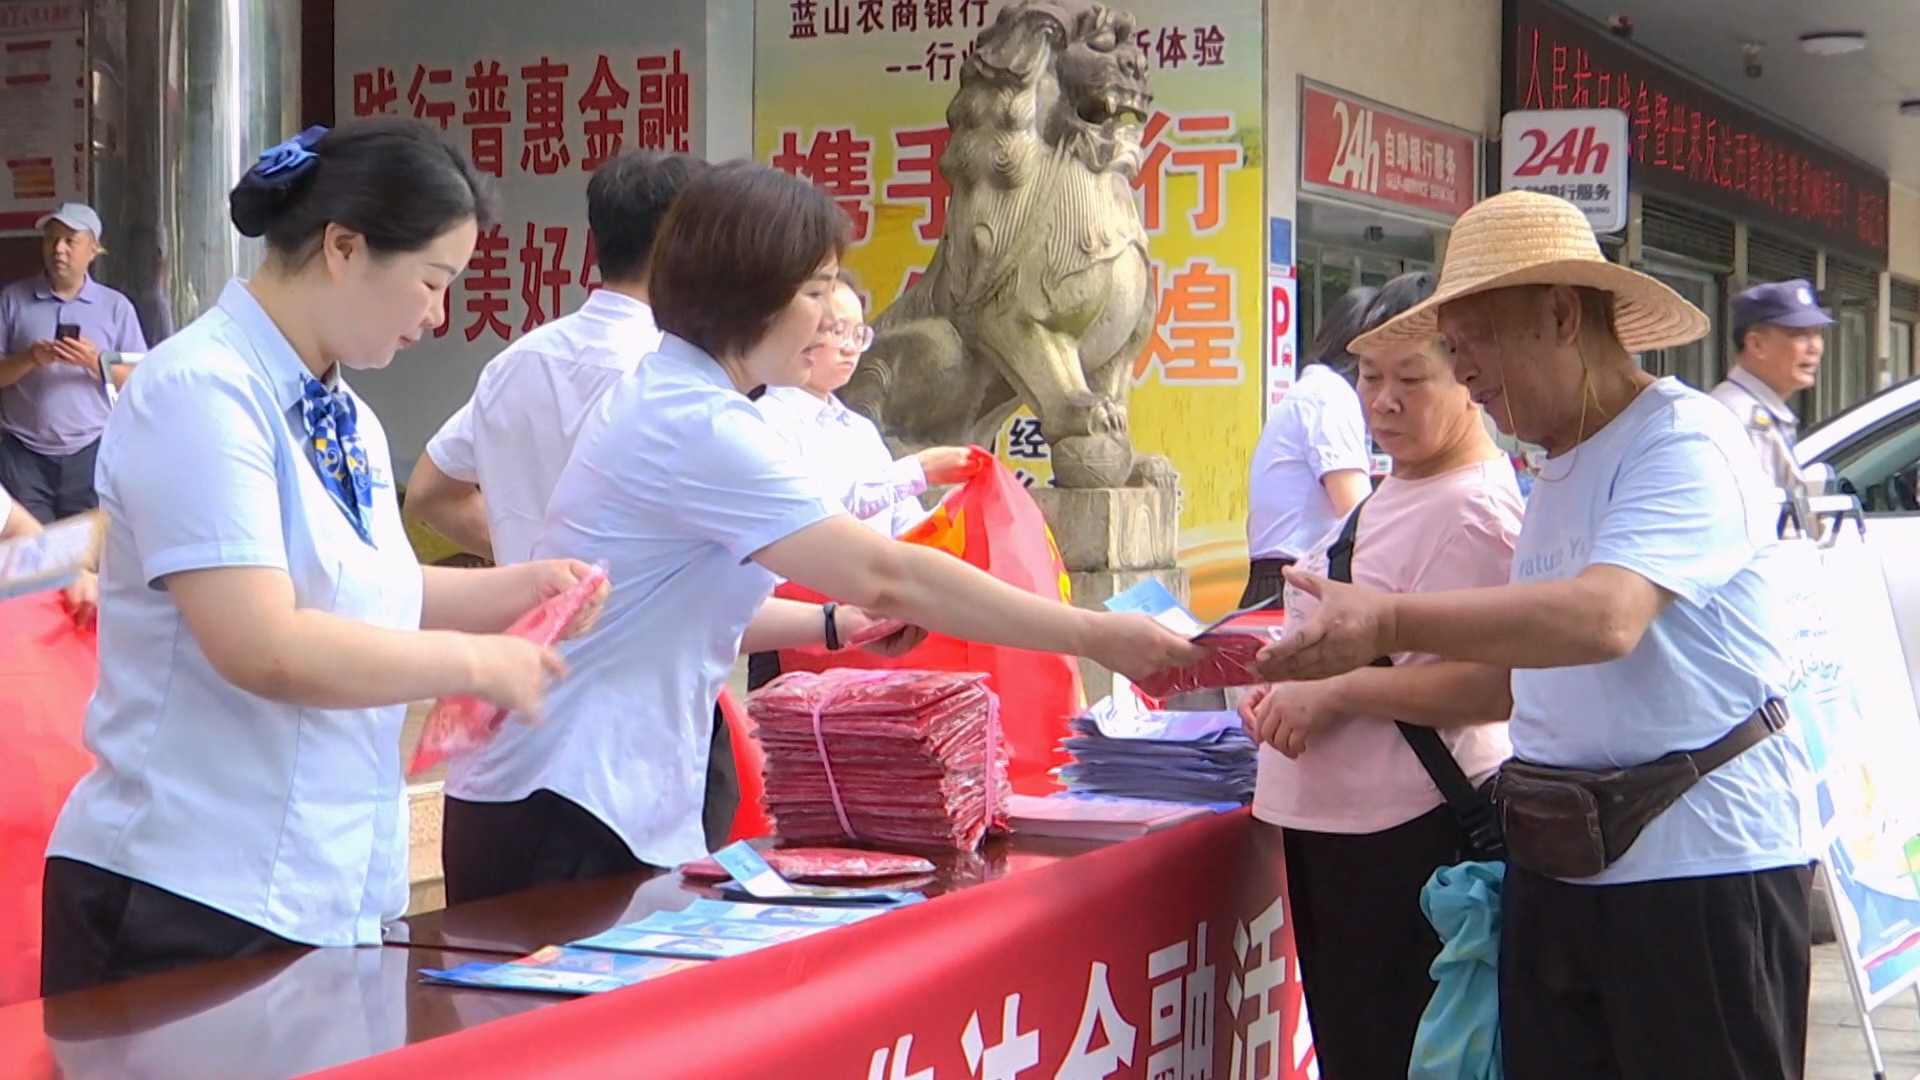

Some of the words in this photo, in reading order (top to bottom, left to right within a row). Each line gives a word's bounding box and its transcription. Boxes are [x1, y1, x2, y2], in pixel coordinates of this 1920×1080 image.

[790, 0, 990, 39] 蓝山农商银行
[1328, 100, 1381, 195] 24h
[1385, 128, 1456, 184] 自助银行服务
[1512, 126, 1610, 176] 24h
[1511, 183, 1611, 201] 银行服务
[433, 222, 603, 342] 美好
[1272, 286, 1290, 367] P
[867, 896, 1321, 1080] 金融活
